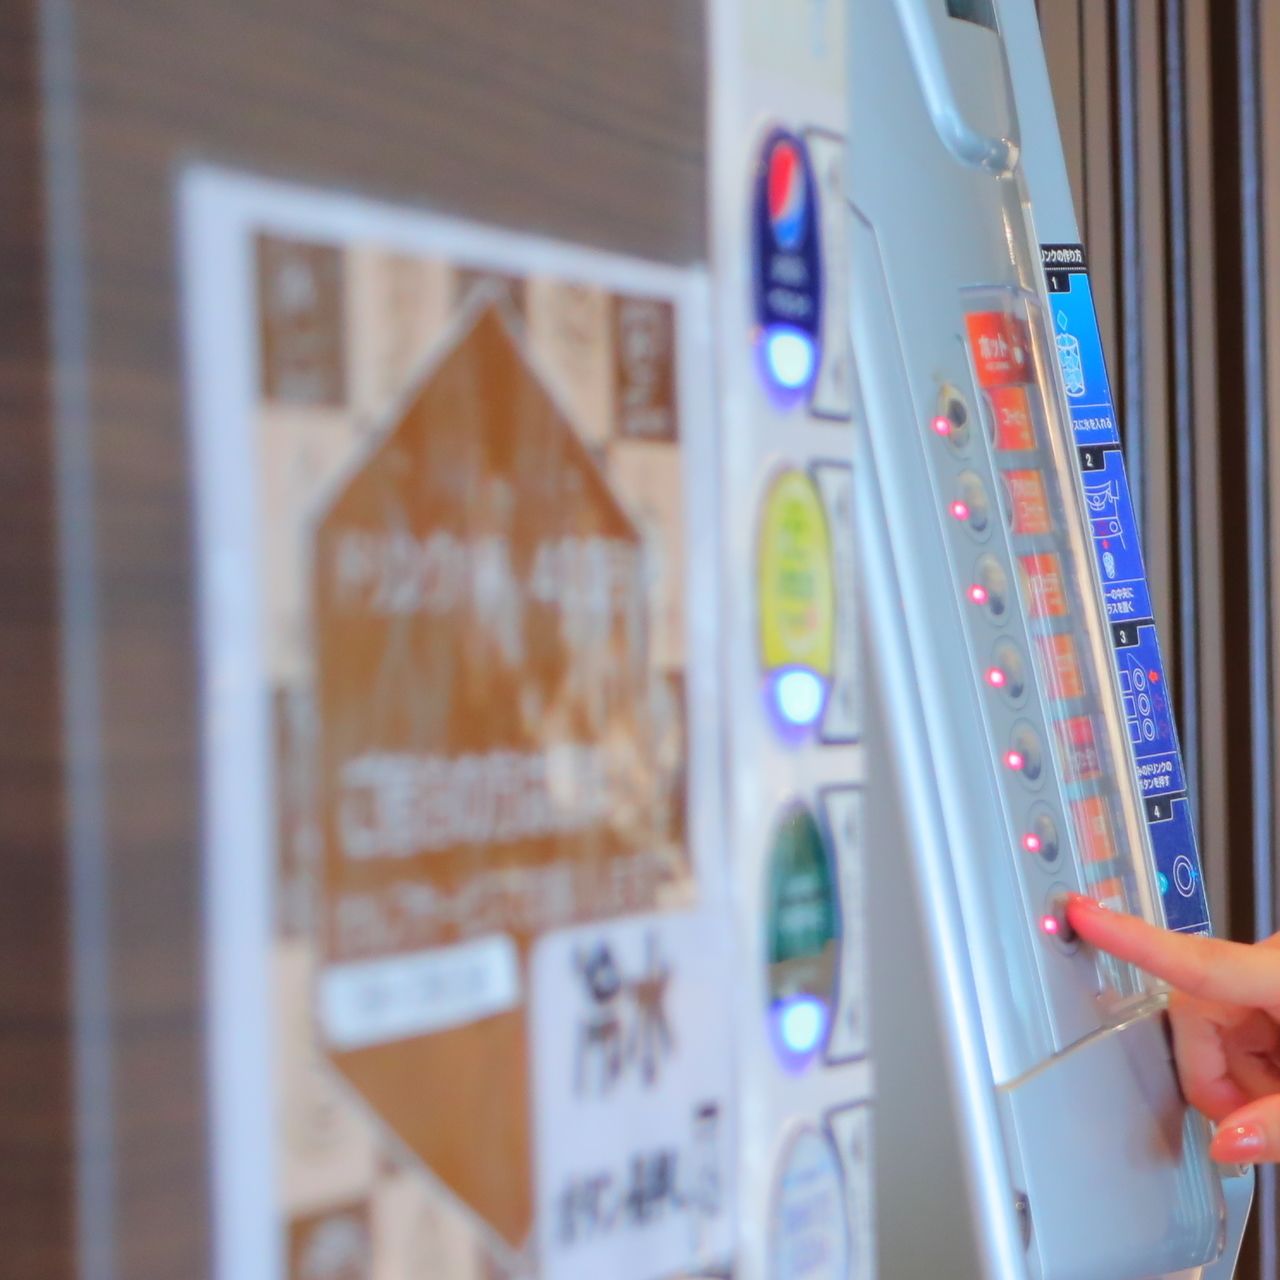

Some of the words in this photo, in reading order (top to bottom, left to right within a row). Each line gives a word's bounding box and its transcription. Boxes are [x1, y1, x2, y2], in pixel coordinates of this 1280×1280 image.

[1051, 276, 1057, 290] 1
[1085, 453, 1093, 468] 2
[1119, 630, 1126, 644] 3
[1154, 805, 1161, 819] 4
